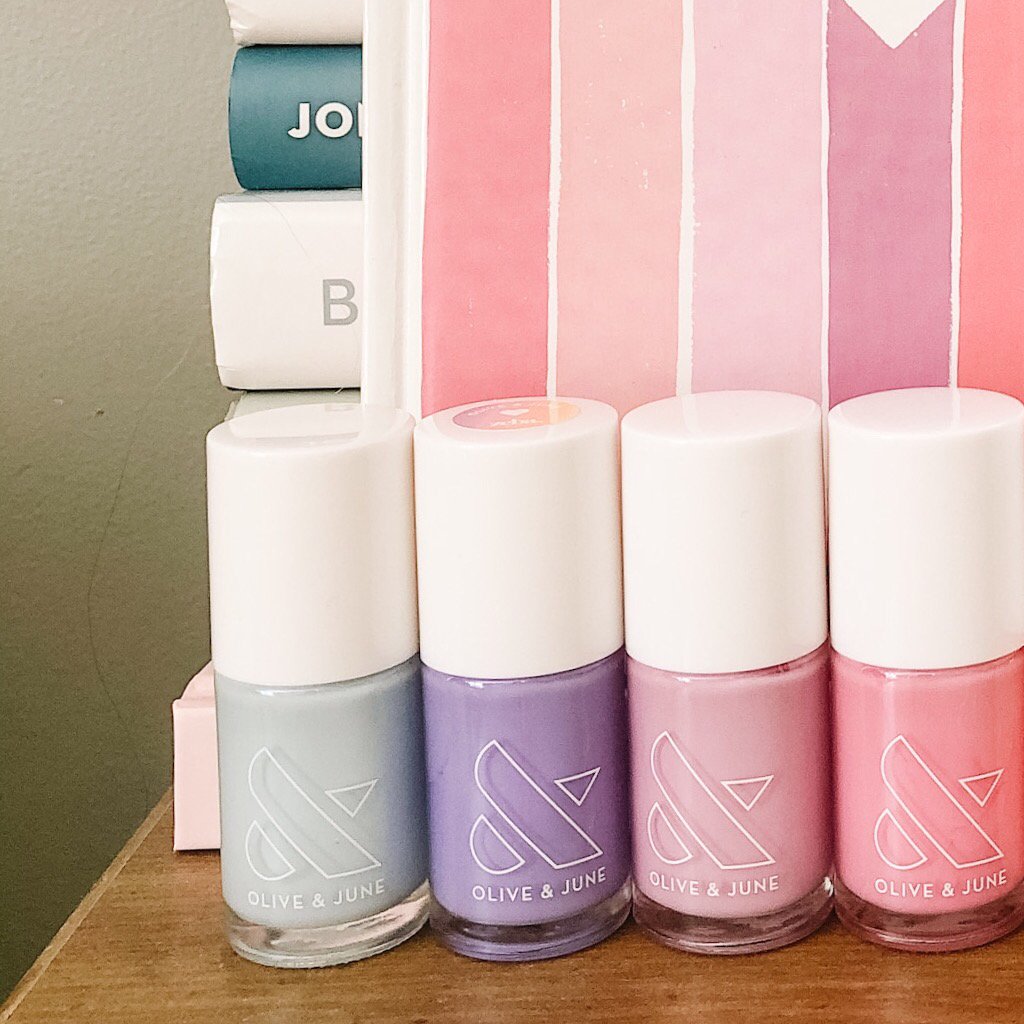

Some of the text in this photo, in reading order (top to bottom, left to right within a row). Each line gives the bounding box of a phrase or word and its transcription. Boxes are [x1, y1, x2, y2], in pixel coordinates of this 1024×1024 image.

[287, 101, 363, 139] JO
[248, 878, 386, 910] OLIVE & JUNE
[472, 866, 607, 903] OLIVE & JUNE
[649, 871, 780, 897] OLIVE & JUNE
[874, 869, 1008, 899] OLIVE & JUNE
